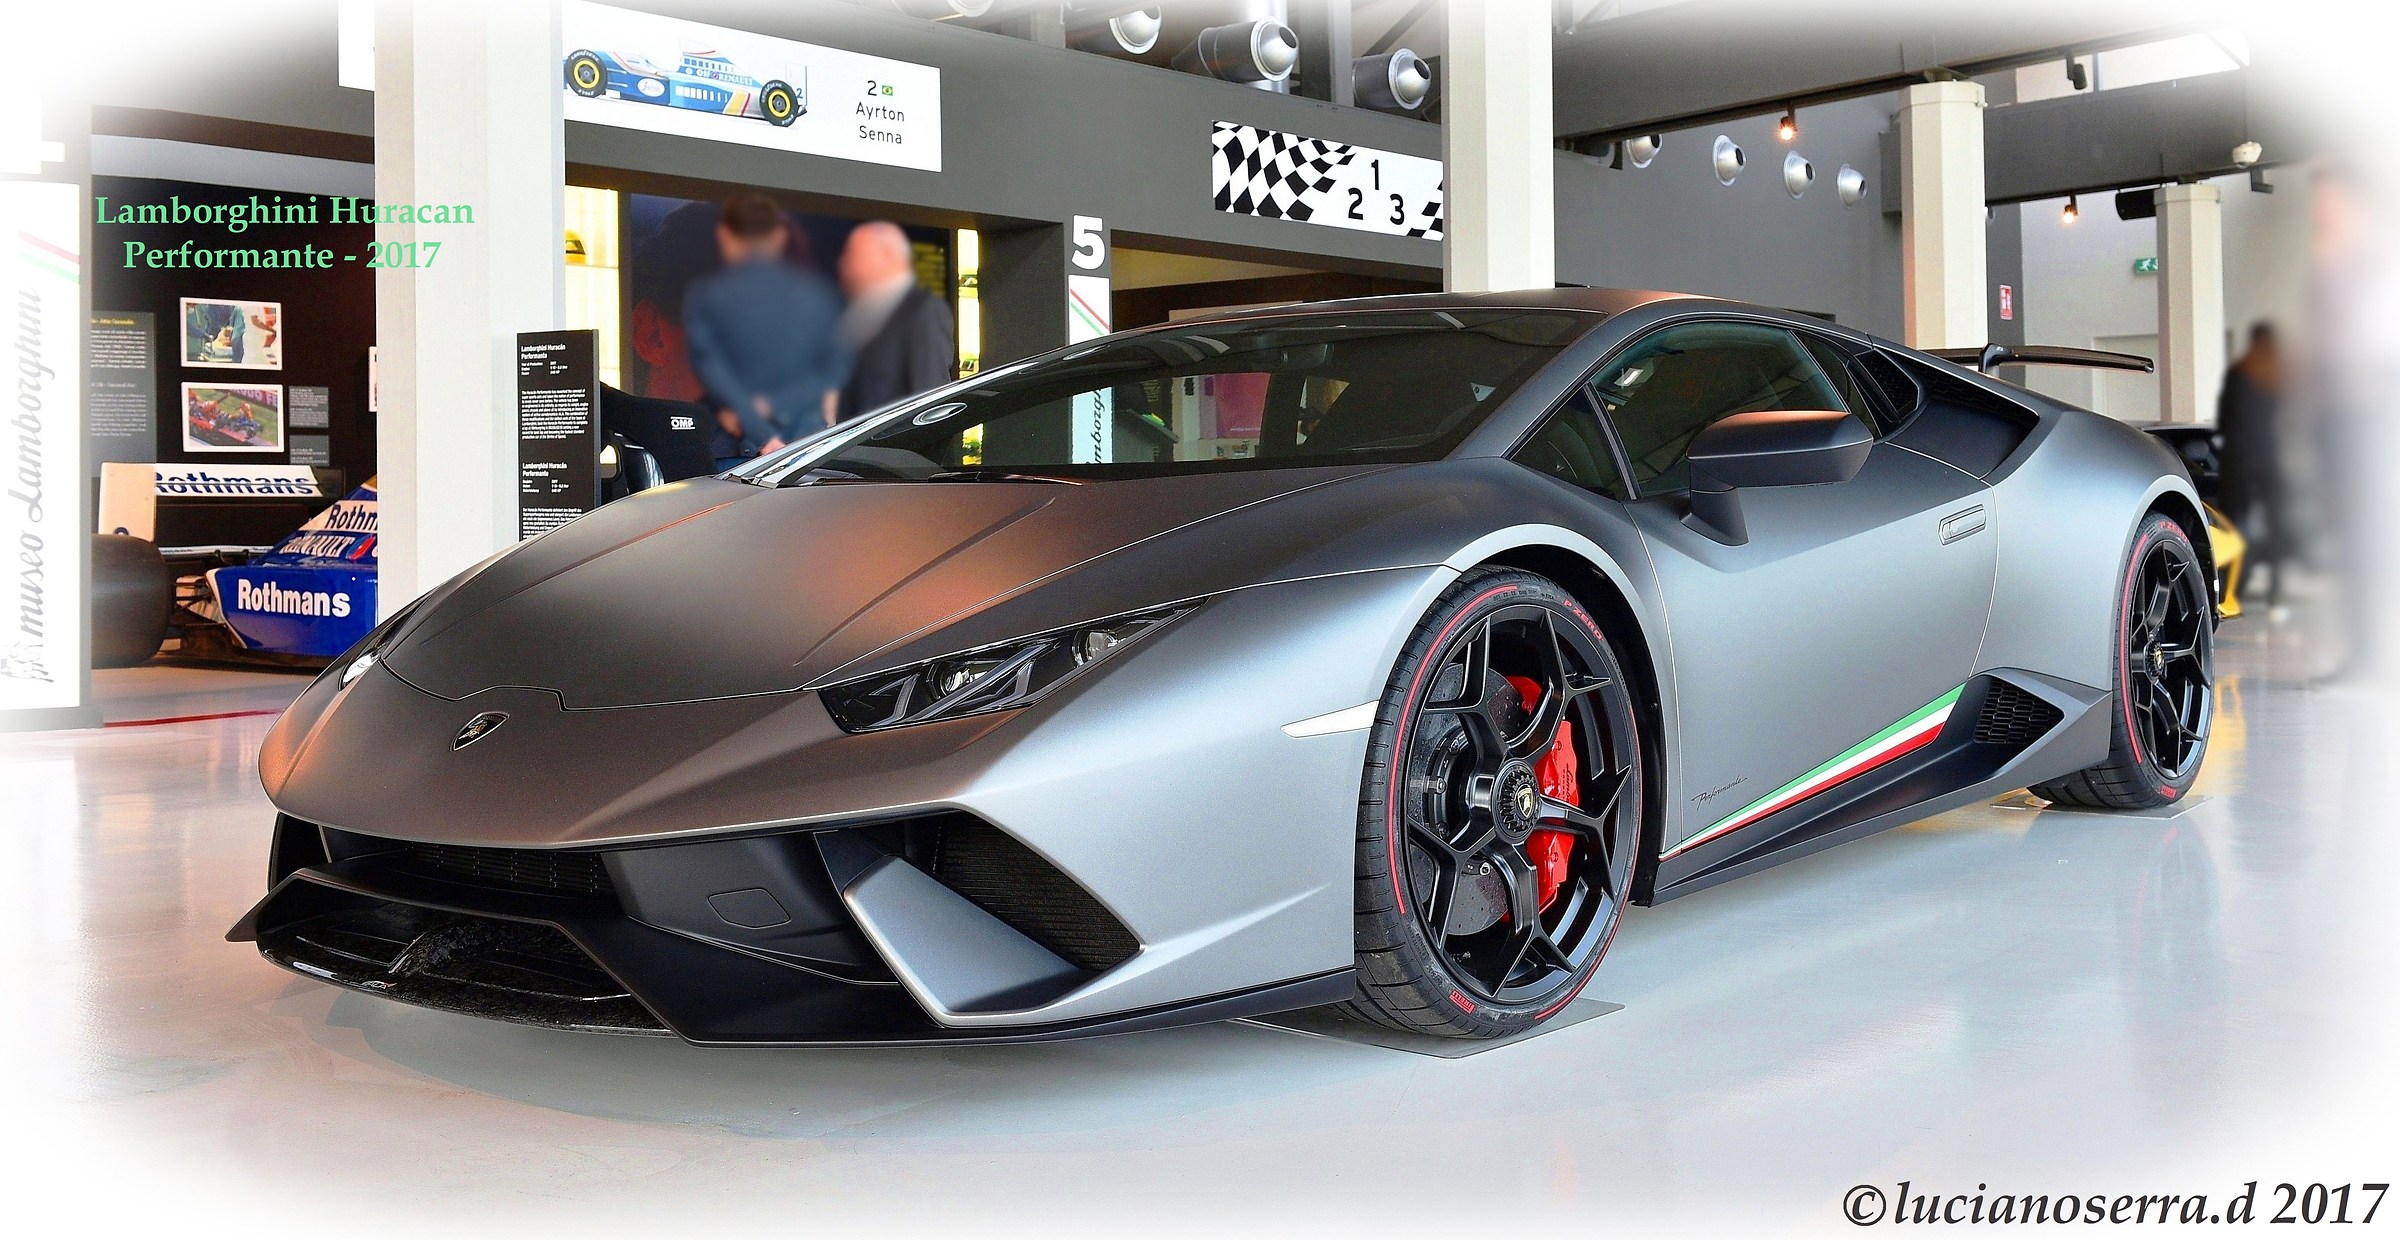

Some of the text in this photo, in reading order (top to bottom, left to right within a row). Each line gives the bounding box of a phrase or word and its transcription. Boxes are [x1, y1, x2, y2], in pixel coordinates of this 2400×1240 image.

[867, 80, 878, 96] 2
[855, 101, 905, 122] Ayrton
[859, 125, 902, 144] Senna
[1370, 159, 1381, 191] 1
[1348, 187, 1405, 226] 2 3
[1071, 215, 1106, 270] 5
[671, 418, 694, 429] OMP
[7, 285, 56, 638] museo Lamborghini
[238, 578, 351, 618] Rothmans
[1573, 607, 1604, 641] ZERO
